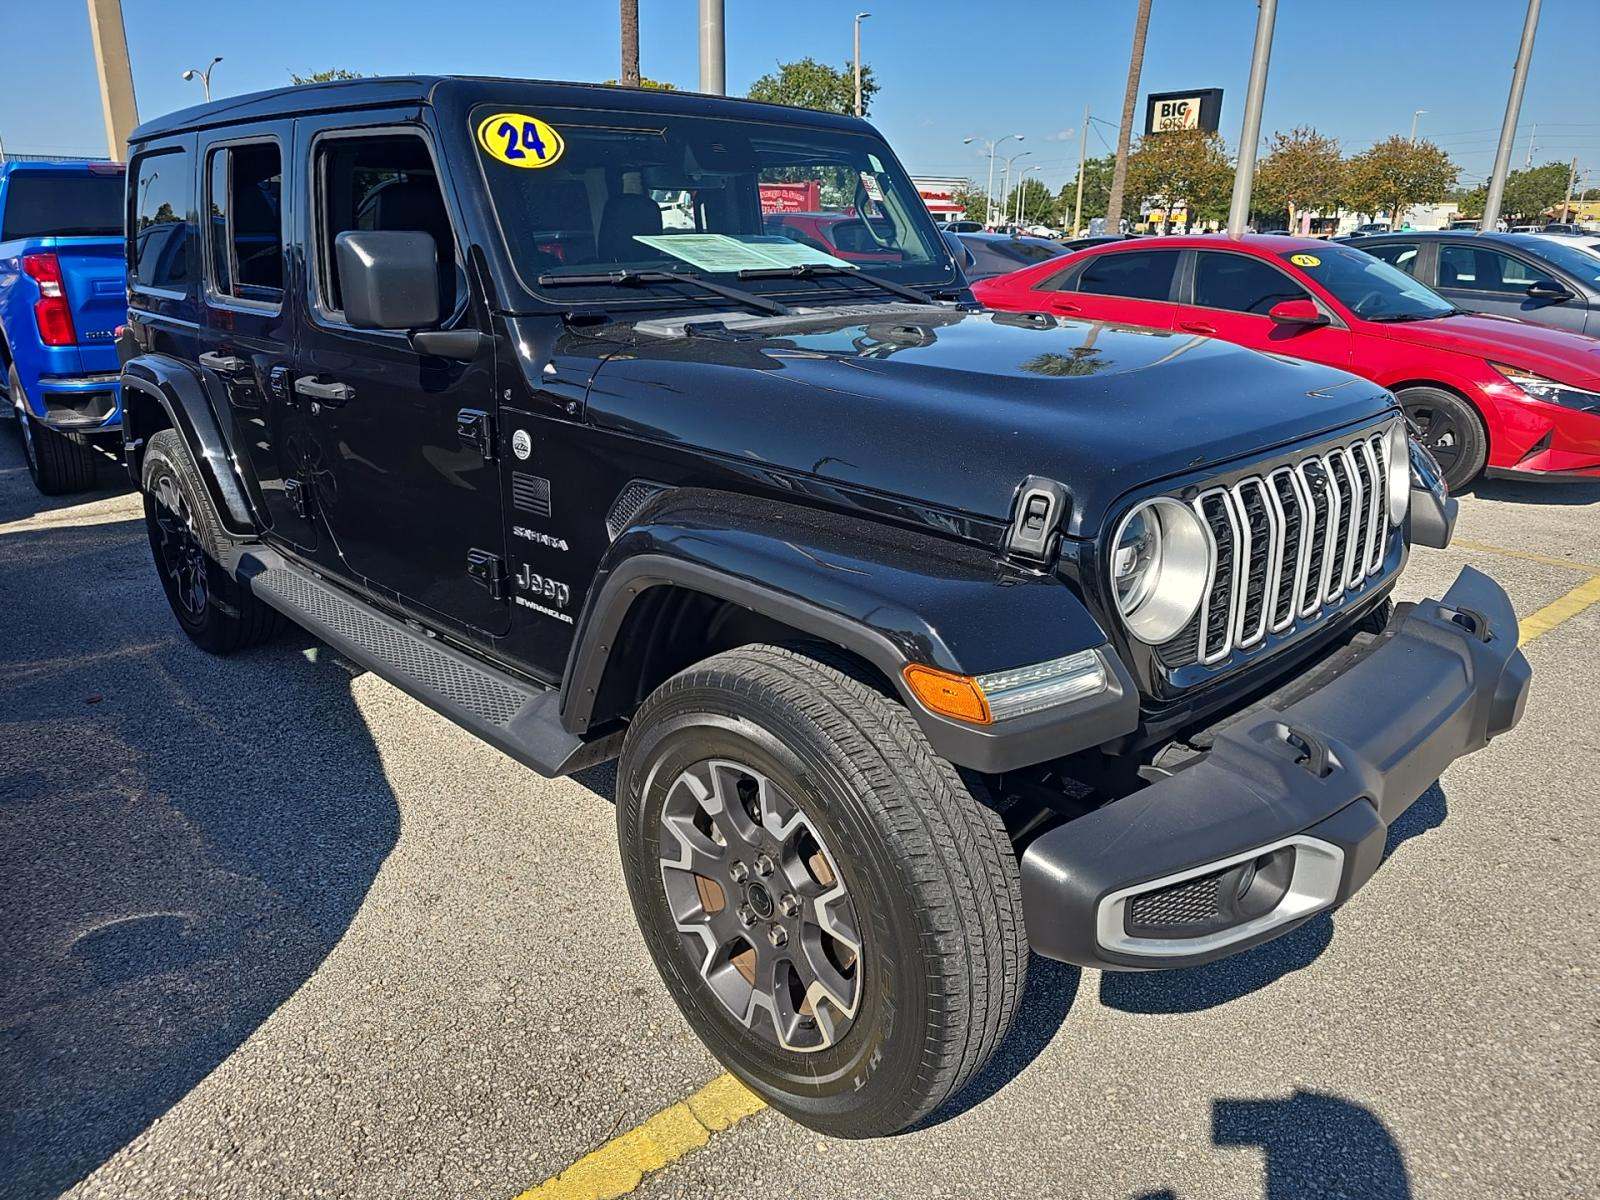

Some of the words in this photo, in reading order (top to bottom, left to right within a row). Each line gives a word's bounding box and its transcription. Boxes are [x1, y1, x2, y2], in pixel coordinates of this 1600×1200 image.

[1161, 101, 1189, 117] BIG
[497, 121, 546, 160] 24
[513, 525, 569, 551] SAHARA
[516, 563, 569, 608] Jeep
[524, 599, 574, 625] WRANGLER
